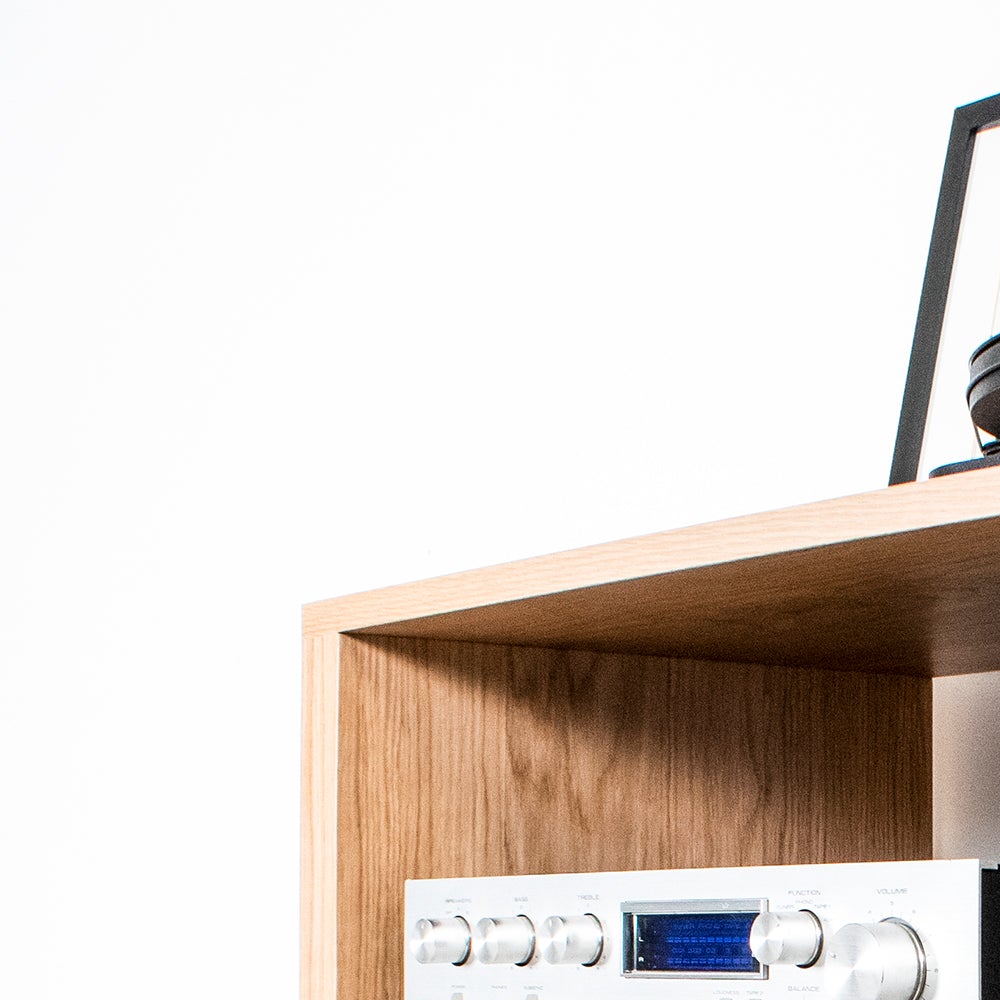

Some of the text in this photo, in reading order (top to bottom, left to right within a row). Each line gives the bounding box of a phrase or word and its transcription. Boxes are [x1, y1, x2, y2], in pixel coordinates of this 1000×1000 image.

[786, 889, 822, 897] FUNCTION
[875, 887, 909, 896] VOLUME
[576, 893, 601, 901] TREBLE
[786, 985, 821, 993] BALANCE
